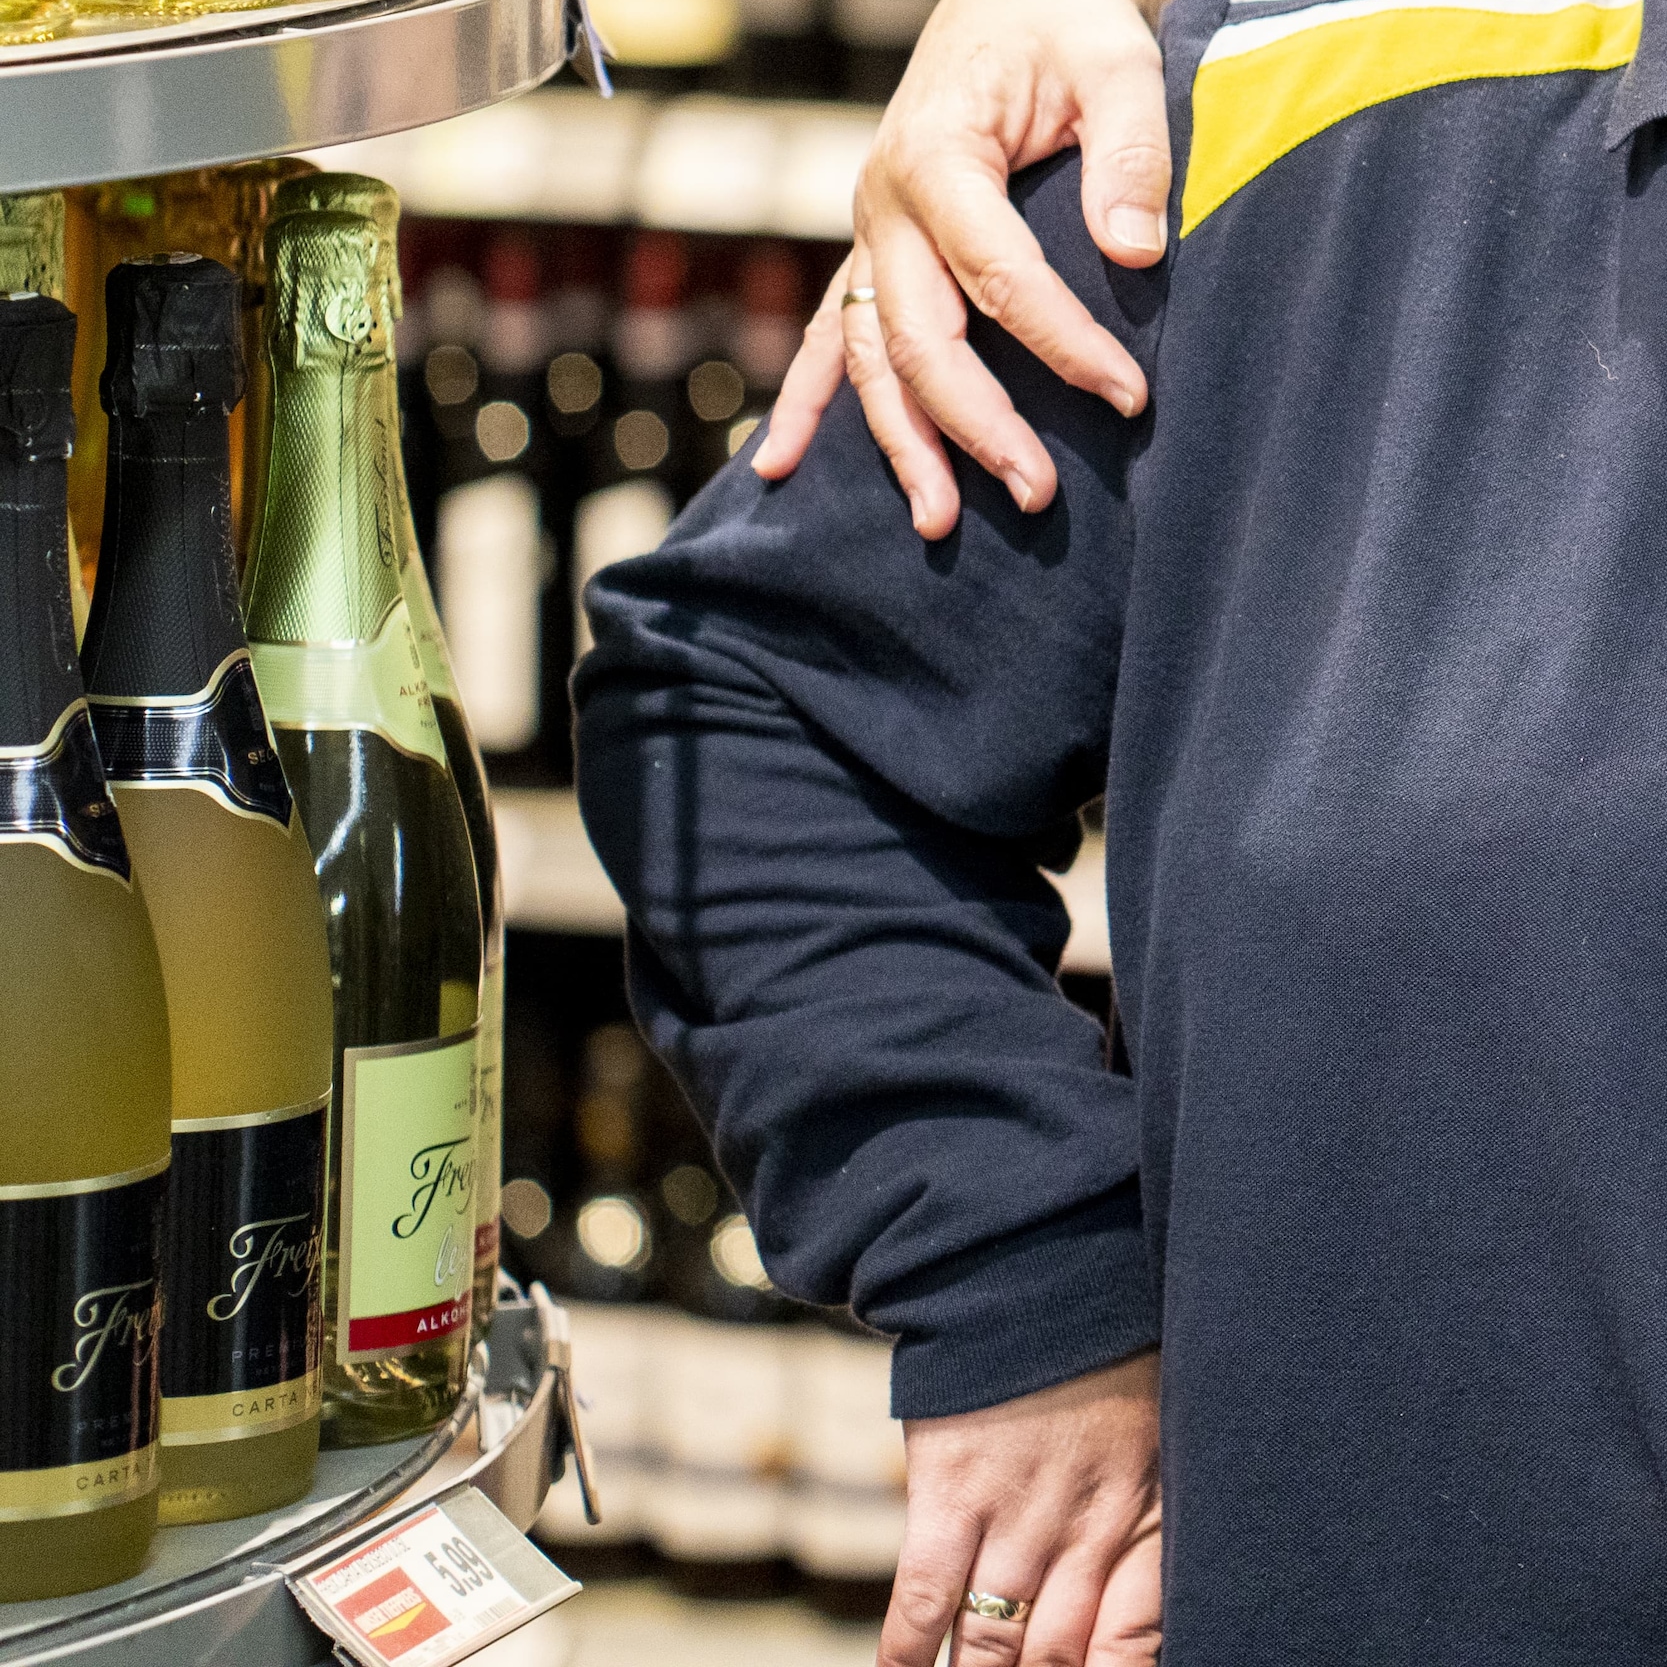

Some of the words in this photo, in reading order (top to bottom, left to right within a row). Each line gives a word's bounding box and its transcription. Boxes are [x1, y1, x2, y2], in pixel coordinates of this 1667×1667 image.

[248, 747, 274, 766] SEC
[232, 1390, 298, 1417] CARTA
[76, 1461, 140, 1491] CARTA
[424, 1536, 495, 1597] 5.99
